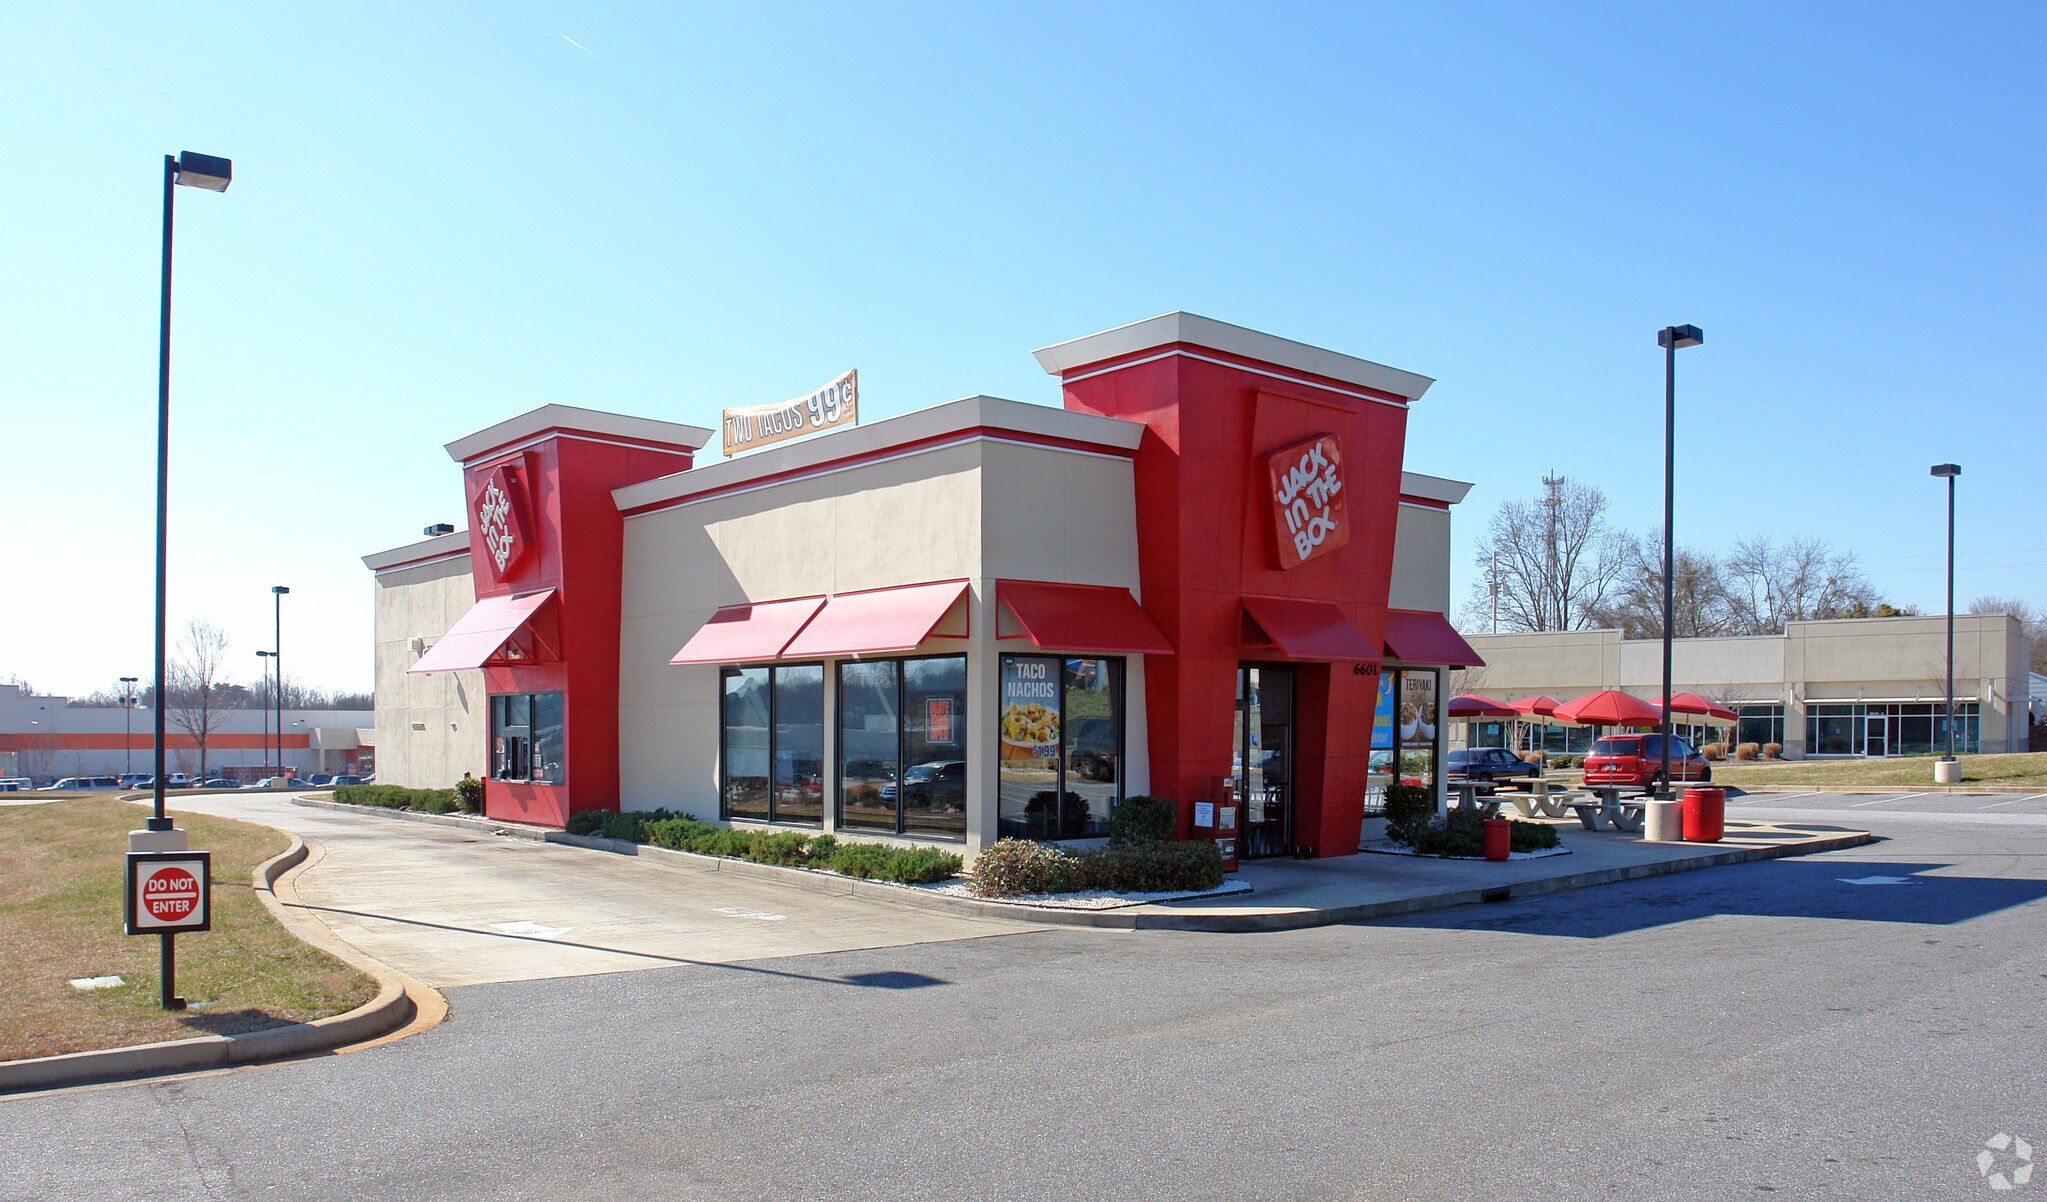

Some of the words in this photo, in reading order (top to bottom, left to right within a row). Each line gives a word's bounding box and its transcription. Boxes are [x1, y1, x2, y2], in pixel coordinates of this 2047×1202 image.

[725, 413, 753, 447] TWO
[1277, 441, 1328, 505] JACK
[480, 477, 500, 535] JACK
[493, 490, 510, 530] THE
[1284, 498, 1310, 534] IN
[1305, 463, 1342, 509] THE
[1293, 505, 1336, 560] BOX
[495, 524, 514, 573] BOX
[1016, 663, 1046, 679] TACO
[1353, 663, 1378, 676] 6601
[1007, 681, 1054, 698] NACHOS
[1405, 678, 1432, 691] TERIYAKI
[1032, 744, 1056, 758] $1.99
[149, 879, 167, 892] DO
[170, 878, 194, 891] NOT
[153, 900, 190, 914] ENTER
